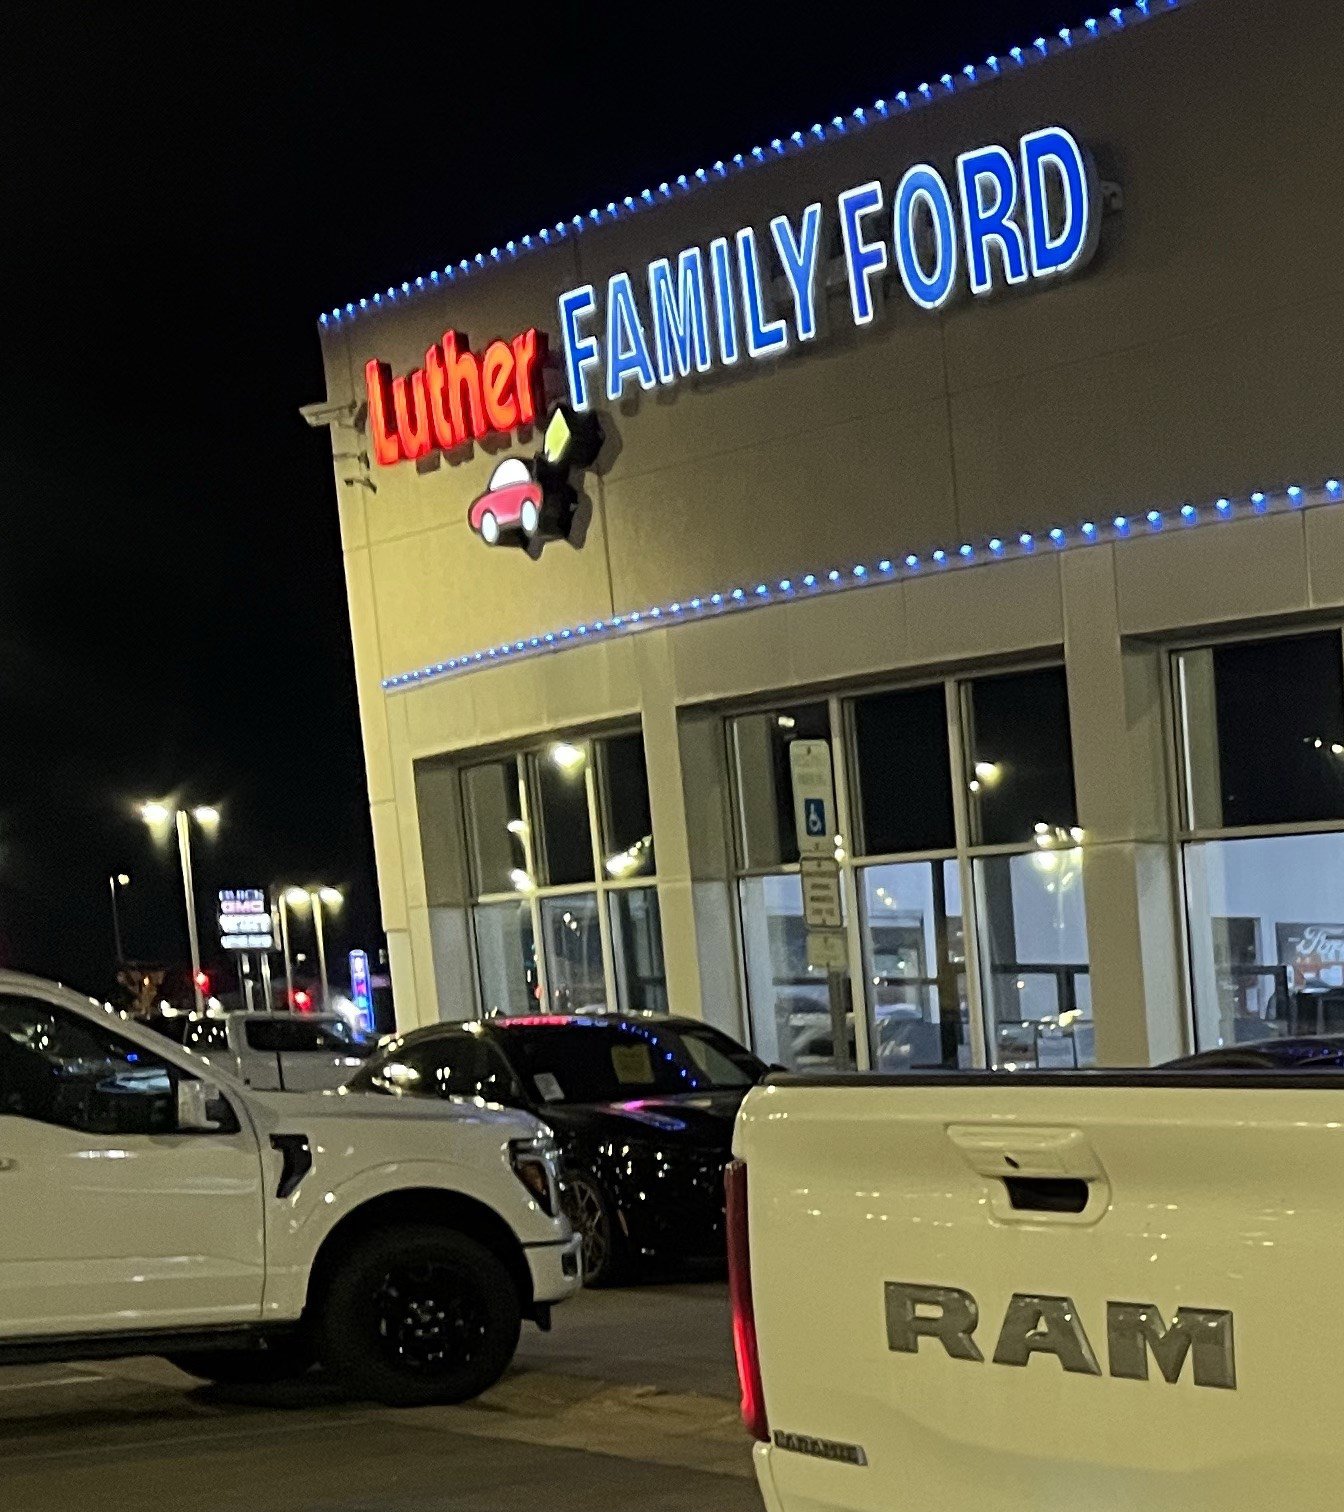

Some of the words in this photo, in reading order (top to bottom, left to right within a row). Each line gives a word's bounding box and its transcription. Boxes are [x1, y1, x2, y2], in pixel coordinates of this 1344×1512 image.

[365, 328, 541, 467] Luther
[558, 201, 822, 413] FAMILY
[838, 125, 1092, 326] FORD
[883, 1280, 1238, 1391] RAM
